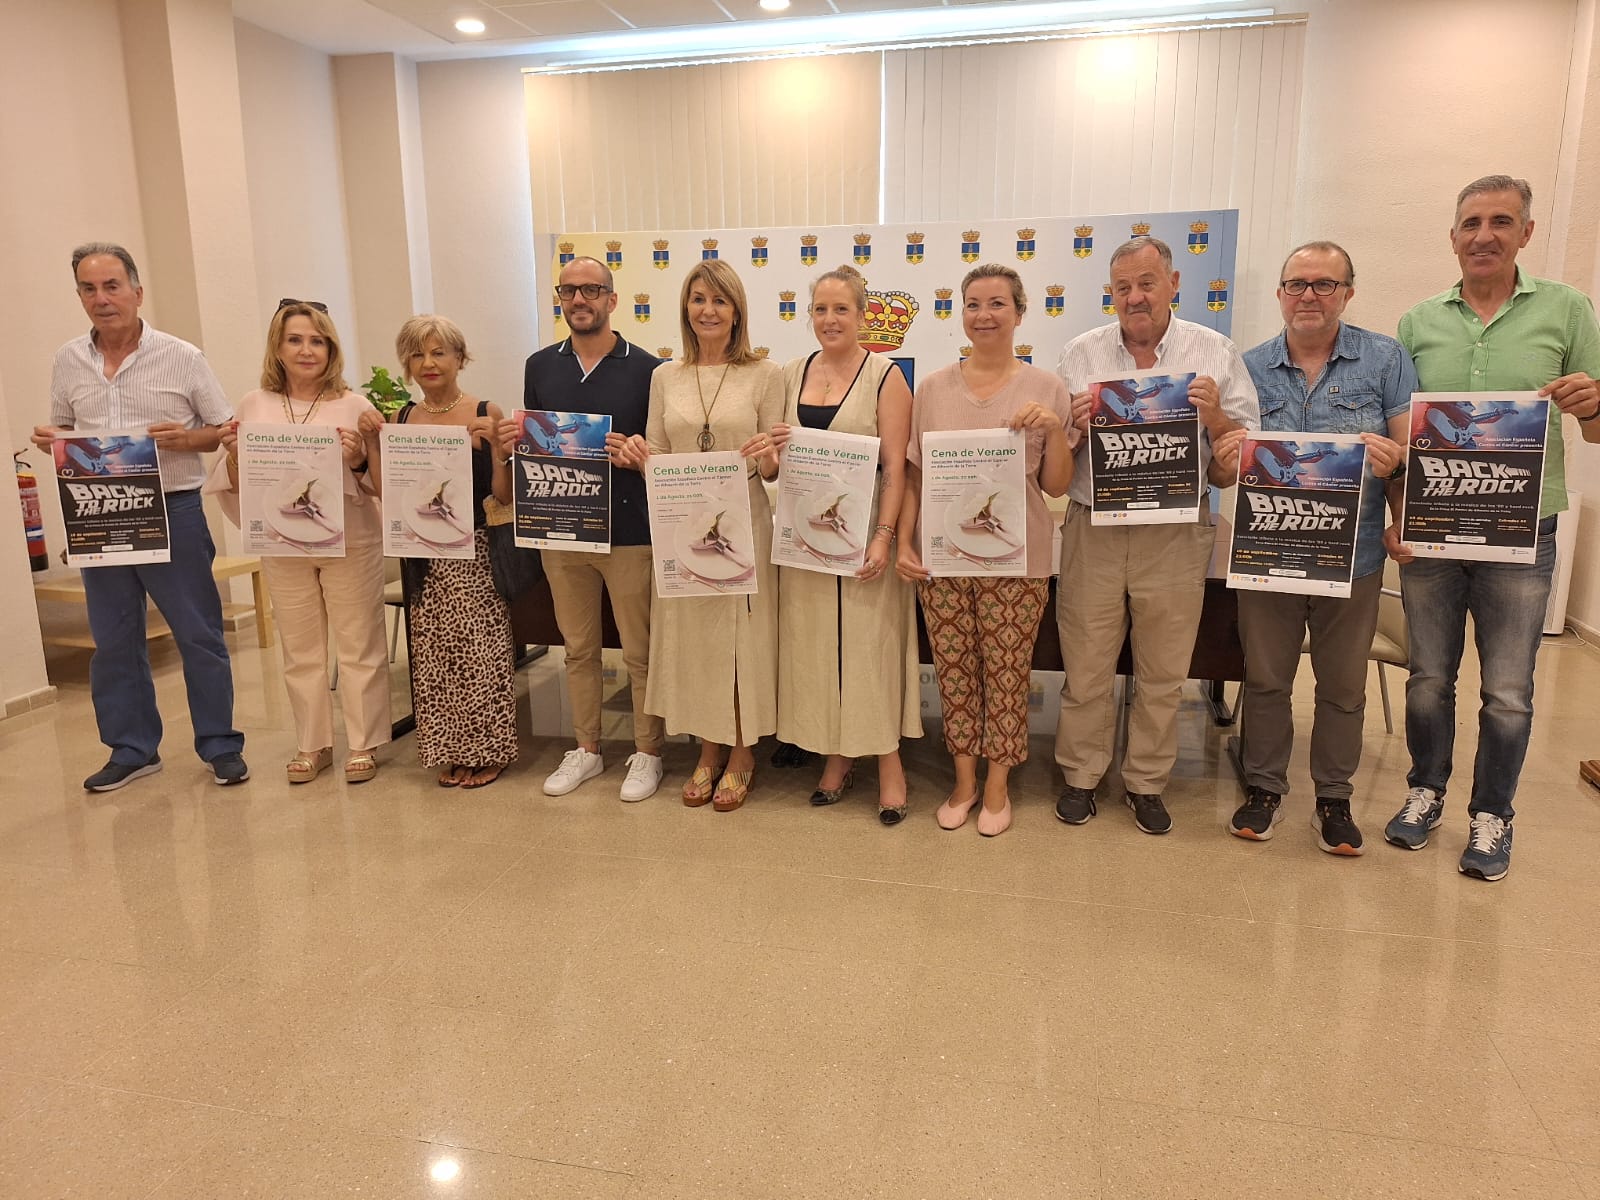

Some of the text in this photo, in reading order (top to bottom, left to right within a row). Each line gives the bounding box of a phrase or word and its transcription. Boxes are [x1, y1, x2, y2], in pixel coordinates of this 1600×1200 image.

[246, 433, 334, 444] Cena de Verano
[388, 435, 464, 445] Cena de Verano
[1097, 432, 1172, 452] BACK
[788, 443, 870, 461] Cena de Verano
[931, 448, 1017, 458] Cena de Verano
[1106, 450, 1129, 461] TO
[1131, 446, 1188, 466] ROCK
[653, 464, 739, 476] Cena de Verano
[1104, 458, 1132, 470] THE
[1418, 456, 1508, 478] BACK
[520, 460, 588, 483] BACK
[528, 480, 549, 490] TO
[550, 482, 602, 497] ROCK
[1426, 478, 1455, 489] TO
[1454, 478, 1529, 496] ROCK
[65, 483, 140, 500] BACK
[526, 489, 551, 498] THE
[1422, 487, 1456, 497] THE
[76, 499, 99, 509] TO
[101, 496, 155, 514] ROCK
[1246, 492, 1329, 516] BACK
[75, 506, 101, 517] THE
[1252, 513, 1279, 524] TO
[1280, 516, 1346, 531] ROCK
[1249, 522, 1280, 531] THE
